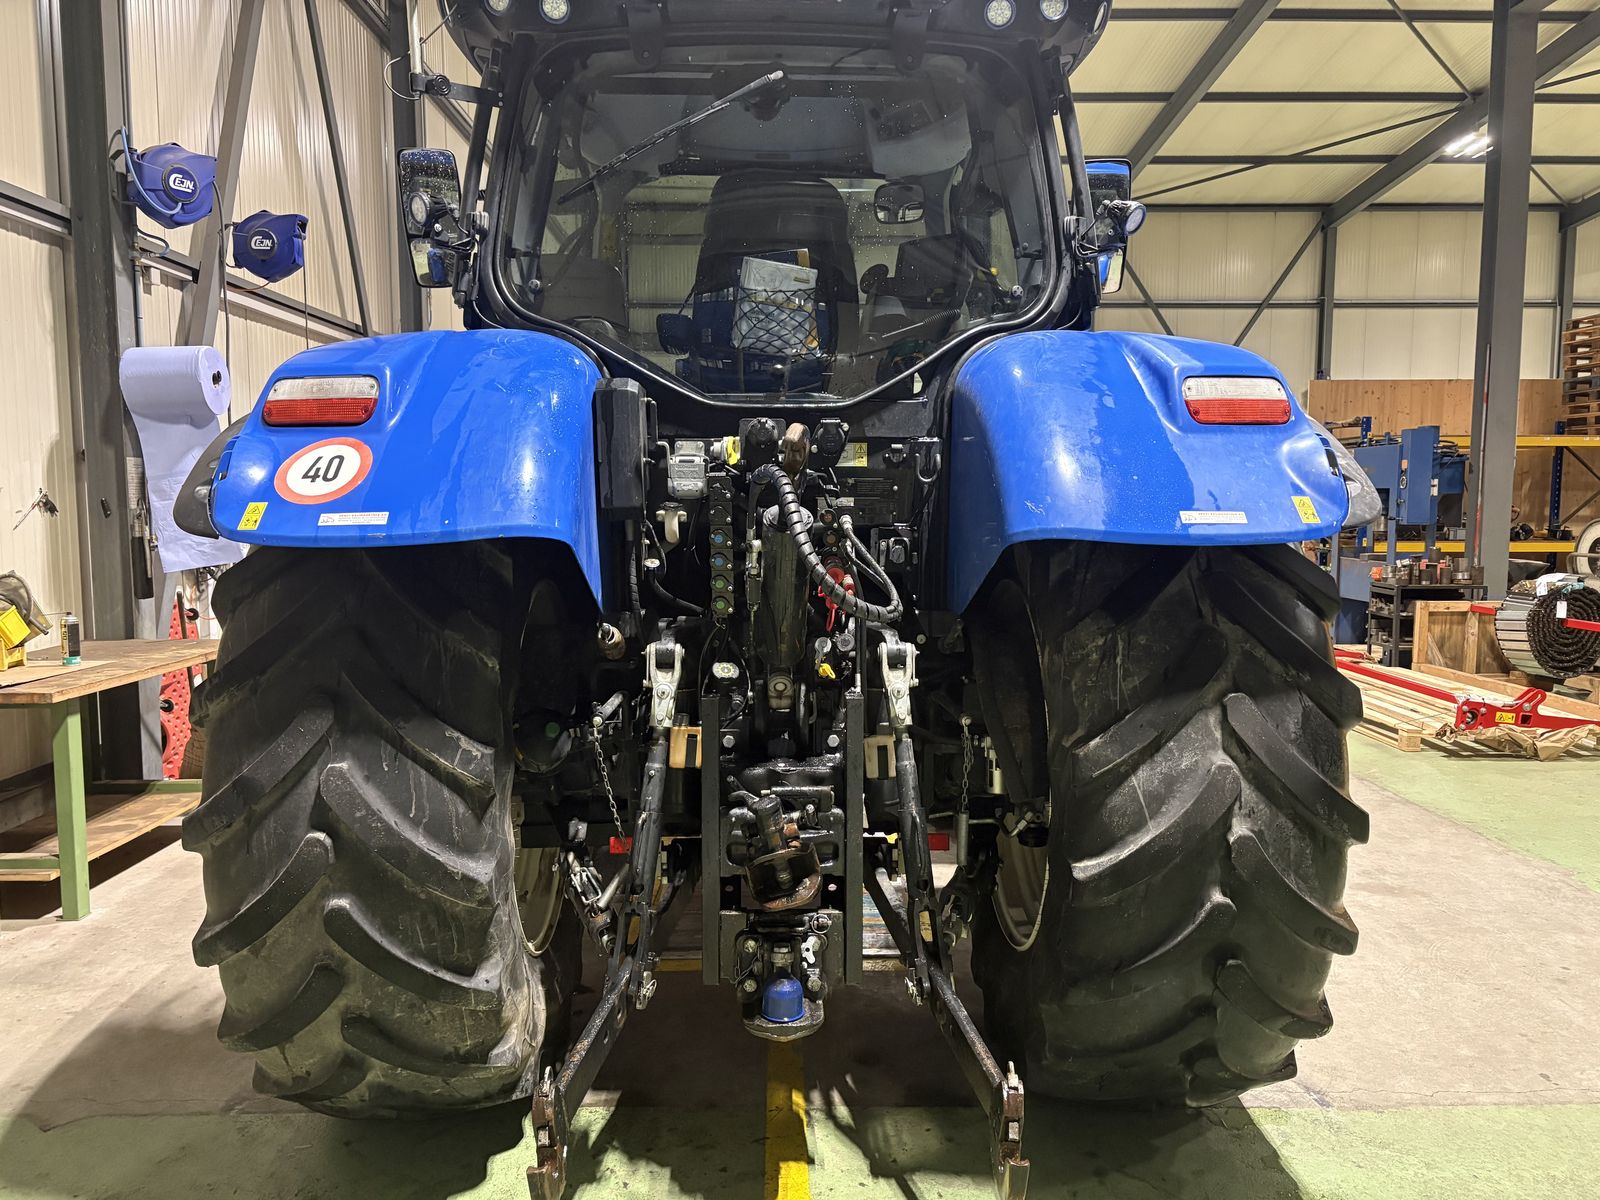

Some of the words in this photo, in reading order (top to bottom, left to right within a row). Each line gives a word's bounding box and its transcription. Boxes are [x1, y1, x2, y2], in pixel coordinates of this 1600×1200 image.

[169, 173, 194, 193] CEJN
[251, 236, 272, 249] CEJN
[301, 455, 345, 483] 40
